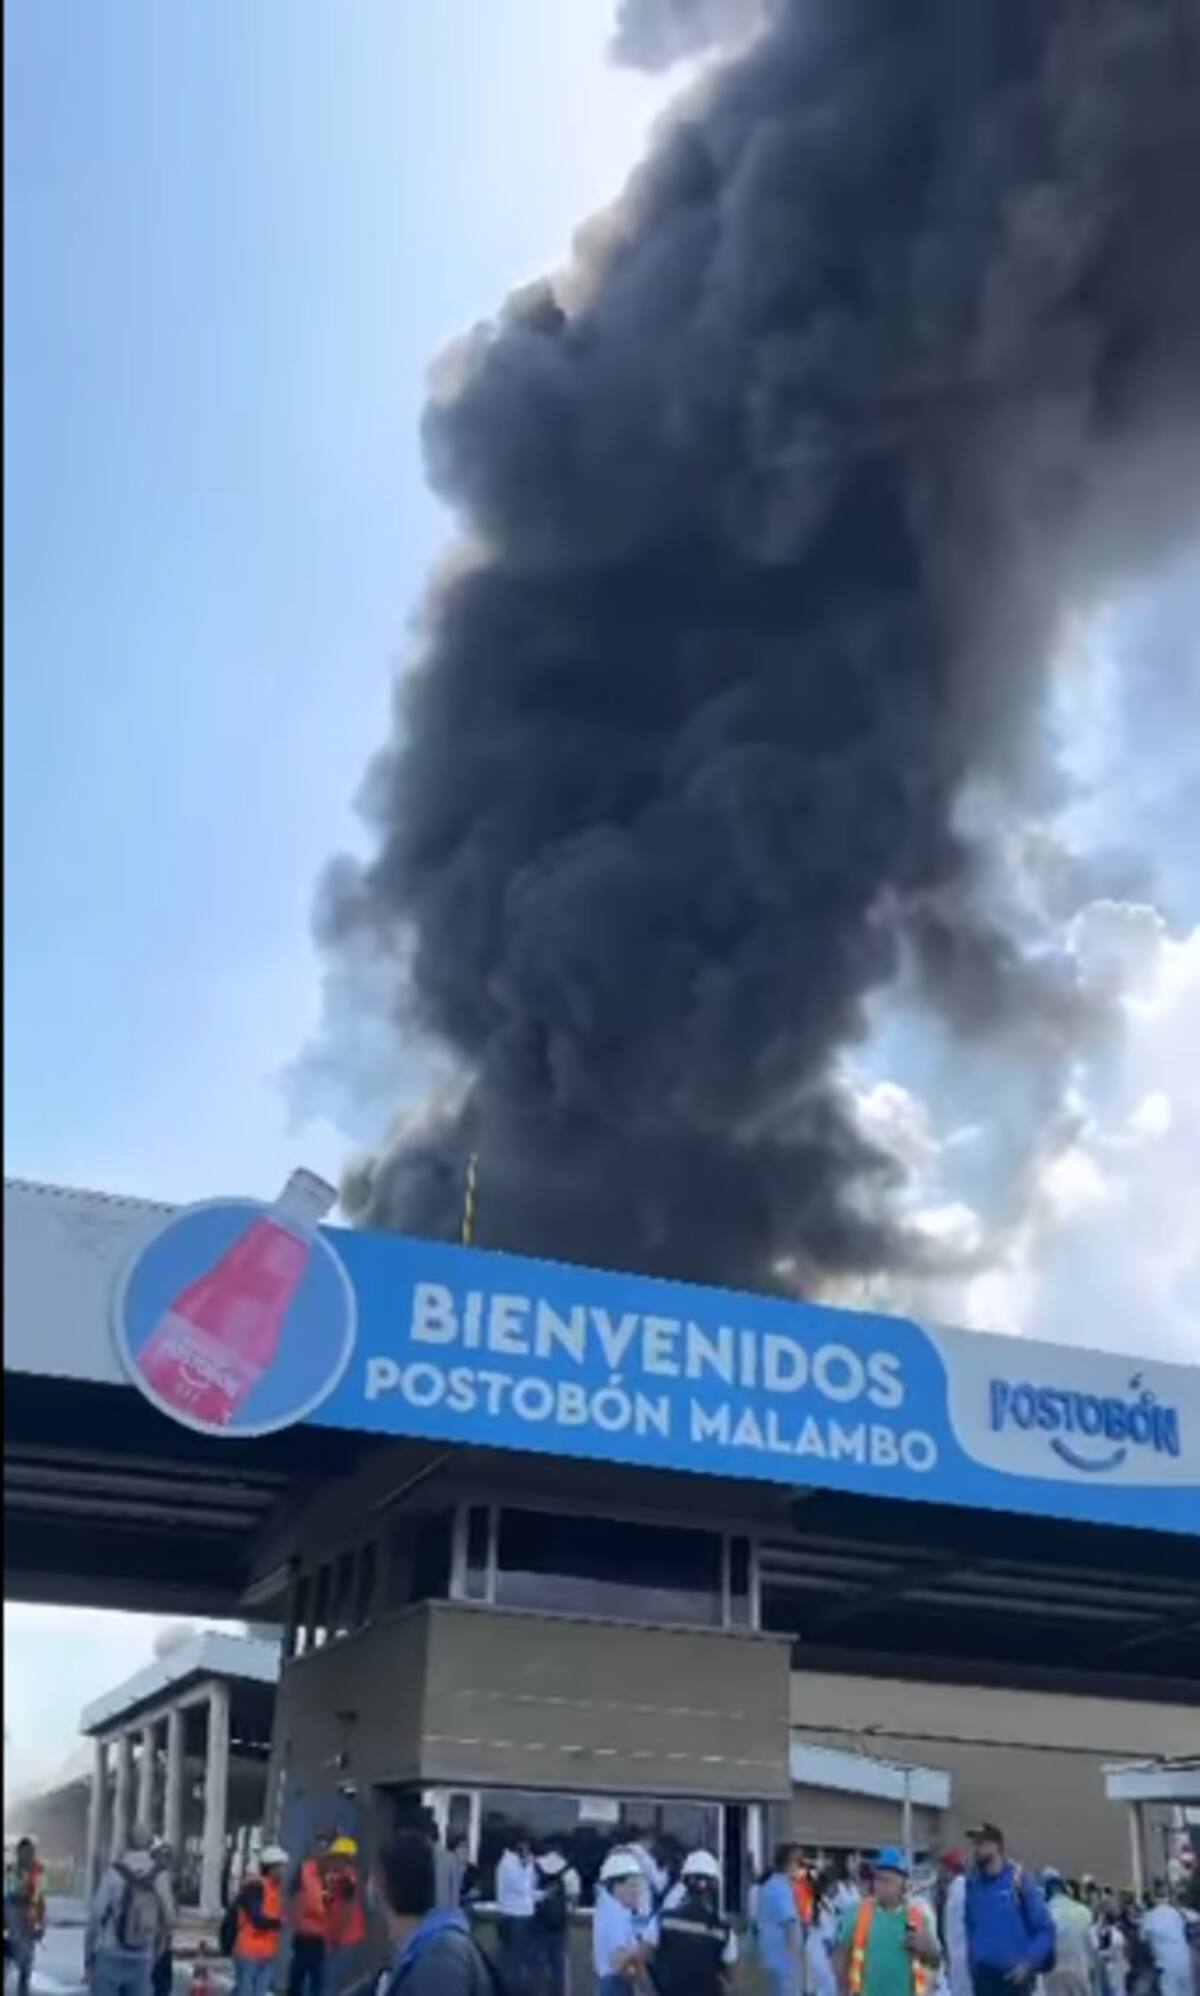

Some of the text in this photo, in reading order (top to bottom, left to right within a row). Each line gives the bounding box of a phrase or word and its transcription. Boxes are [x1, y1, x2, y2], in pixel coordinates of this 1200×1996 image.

[410, 1283, 903, 1408] BIENVENIDOS
[364, 1357, 937, 1472] POSTOBÓN MALAMBO
[989, 1373, 1180, 1457] POSTOBÓN
